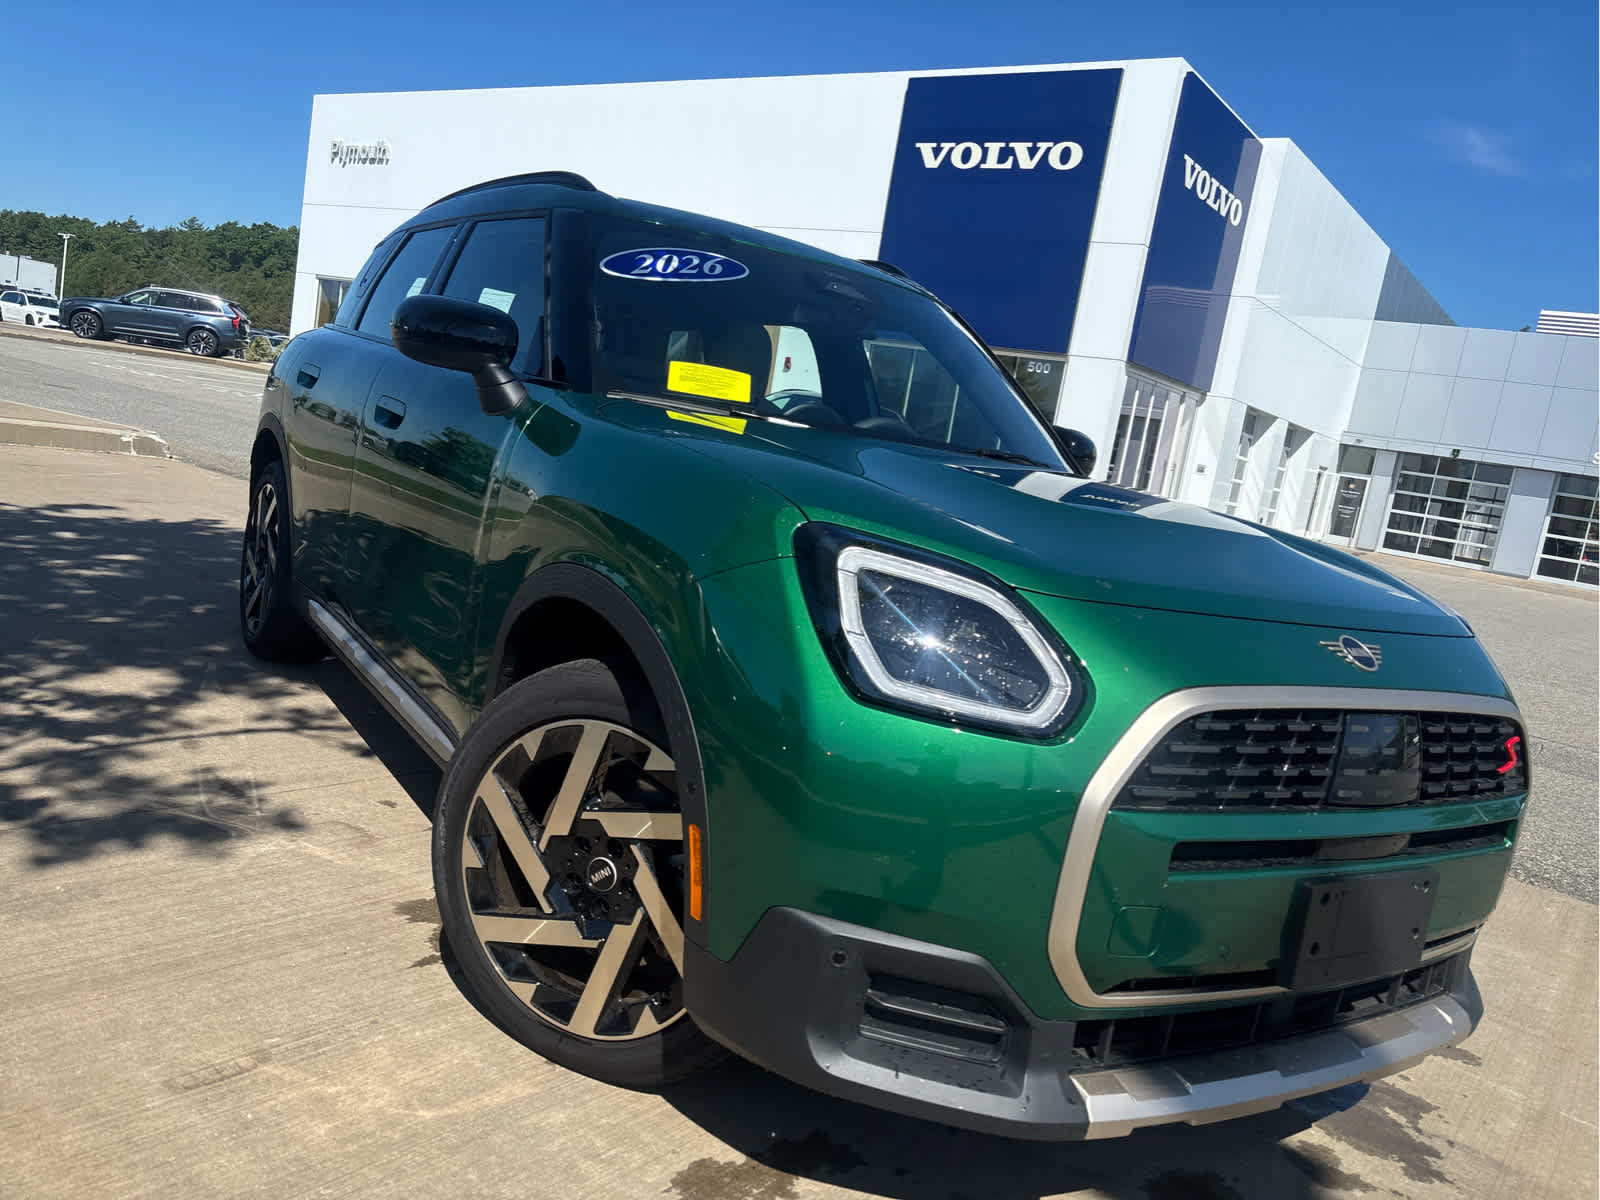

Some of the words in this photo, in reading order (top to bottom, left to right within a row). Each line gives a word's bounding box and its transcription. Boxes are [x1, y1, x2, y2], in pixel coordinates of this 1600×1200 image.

[330, 138, 391, 168] Plymouth
[915, 141, 1083, 170] VOLVO
[1184, 153, 1242, 226] VOLVO
[630, 254, 723, 275] 2026
[1027, 361, 1050, 373] 500
[1496, 735, 1520, 774] S
[591, 866, 612, 884] MINI
